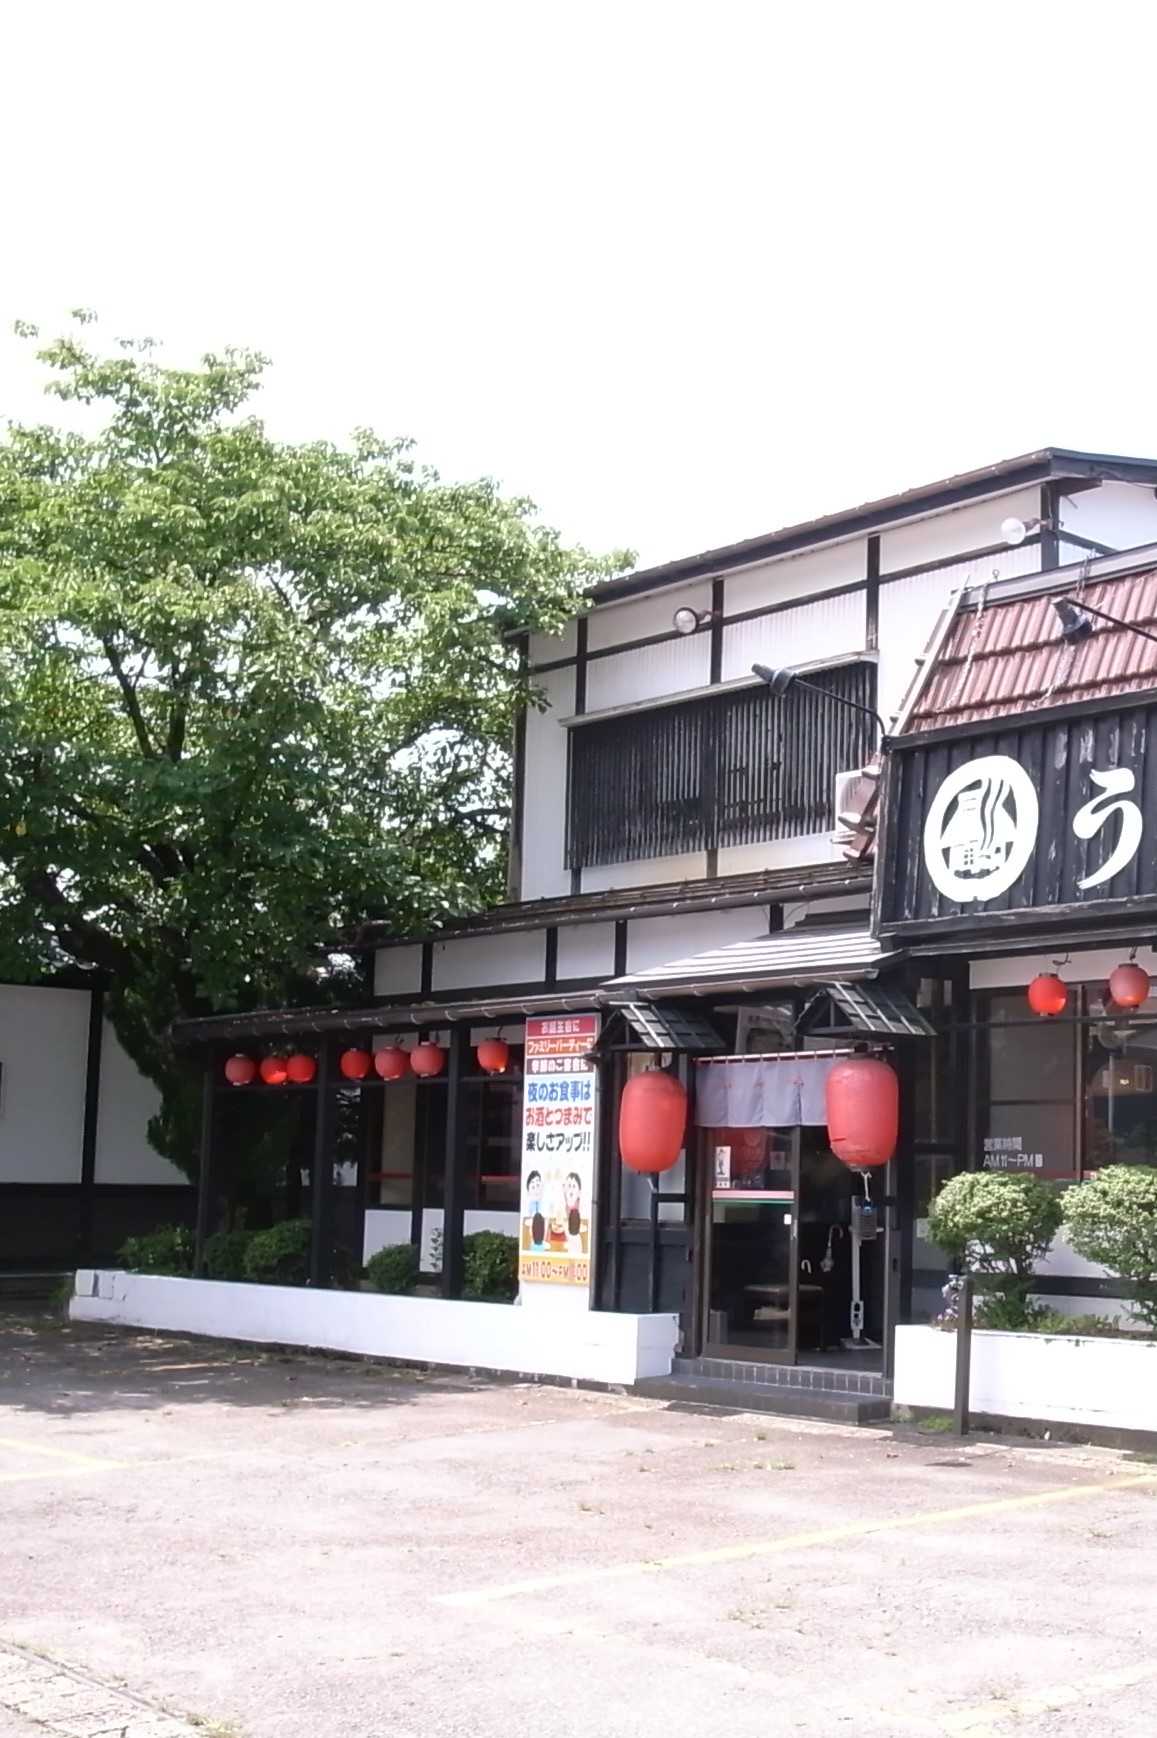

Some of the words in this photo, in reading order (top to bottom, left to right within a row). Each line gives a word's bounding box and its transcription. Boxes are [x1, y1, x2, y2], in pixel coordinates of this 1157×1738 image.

[528, 1081, 591, 1102] 夜のお食事は
[526, 1107, 593, 1127] お酒とつまみで
